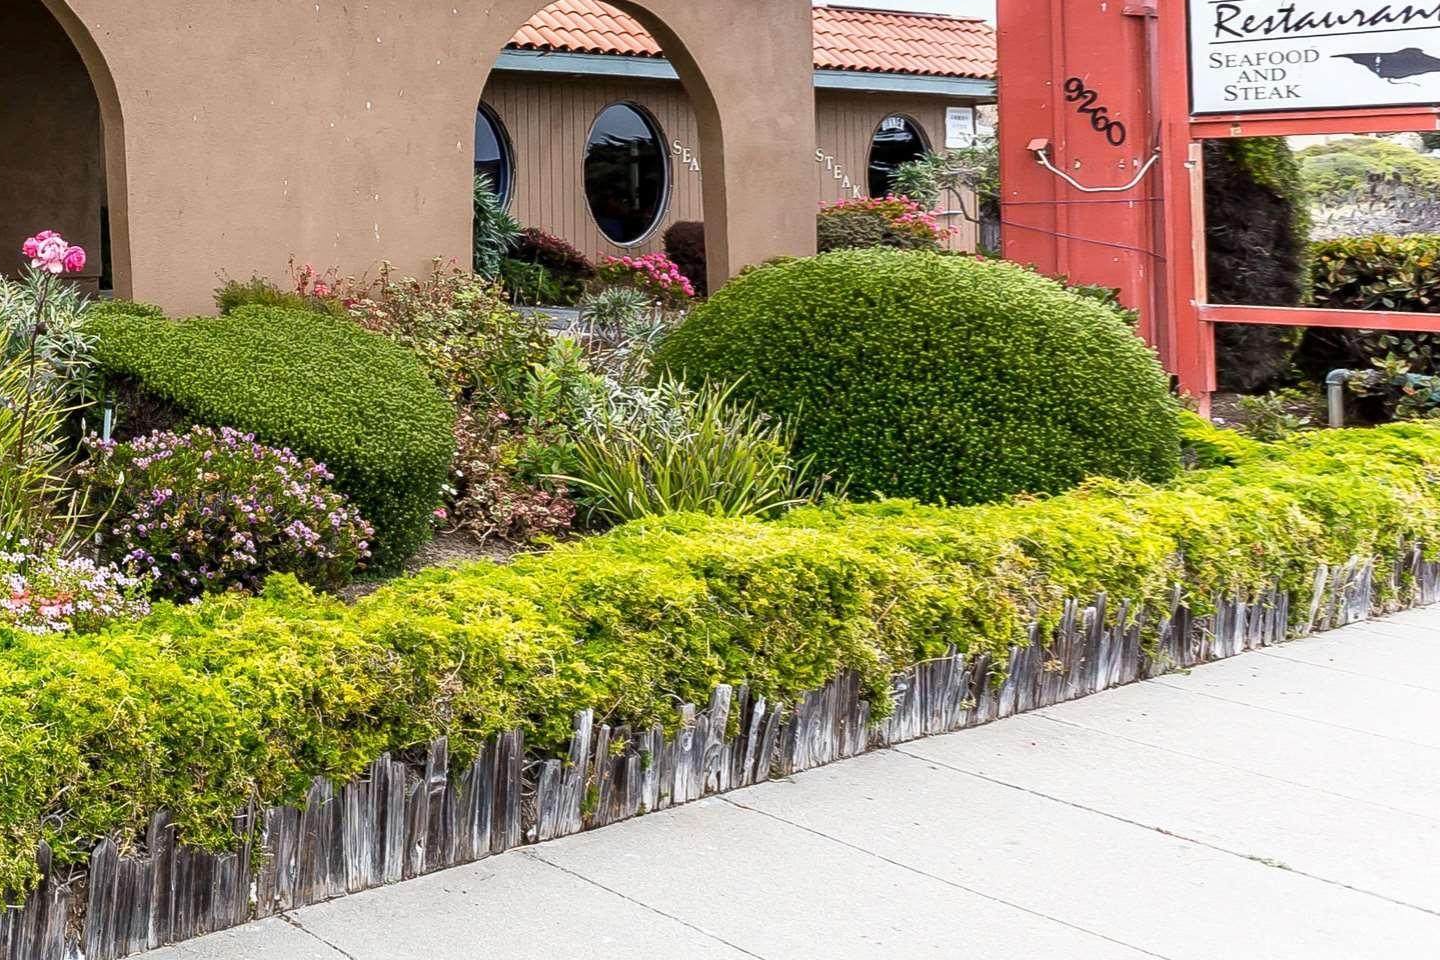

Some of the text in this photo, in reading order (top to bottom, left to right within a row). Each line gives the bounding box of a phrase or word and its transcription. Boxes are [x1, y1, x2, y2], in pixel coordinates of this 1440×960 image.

[1209, 48, 1320, 69] SEAFOOD
[1236, 68, 1287, 83] AND
[1223, 84, 1302, 101] STEAK
[1064, 77, 1126, 147] 9260
[815, 147, 863, 199] STEAK
